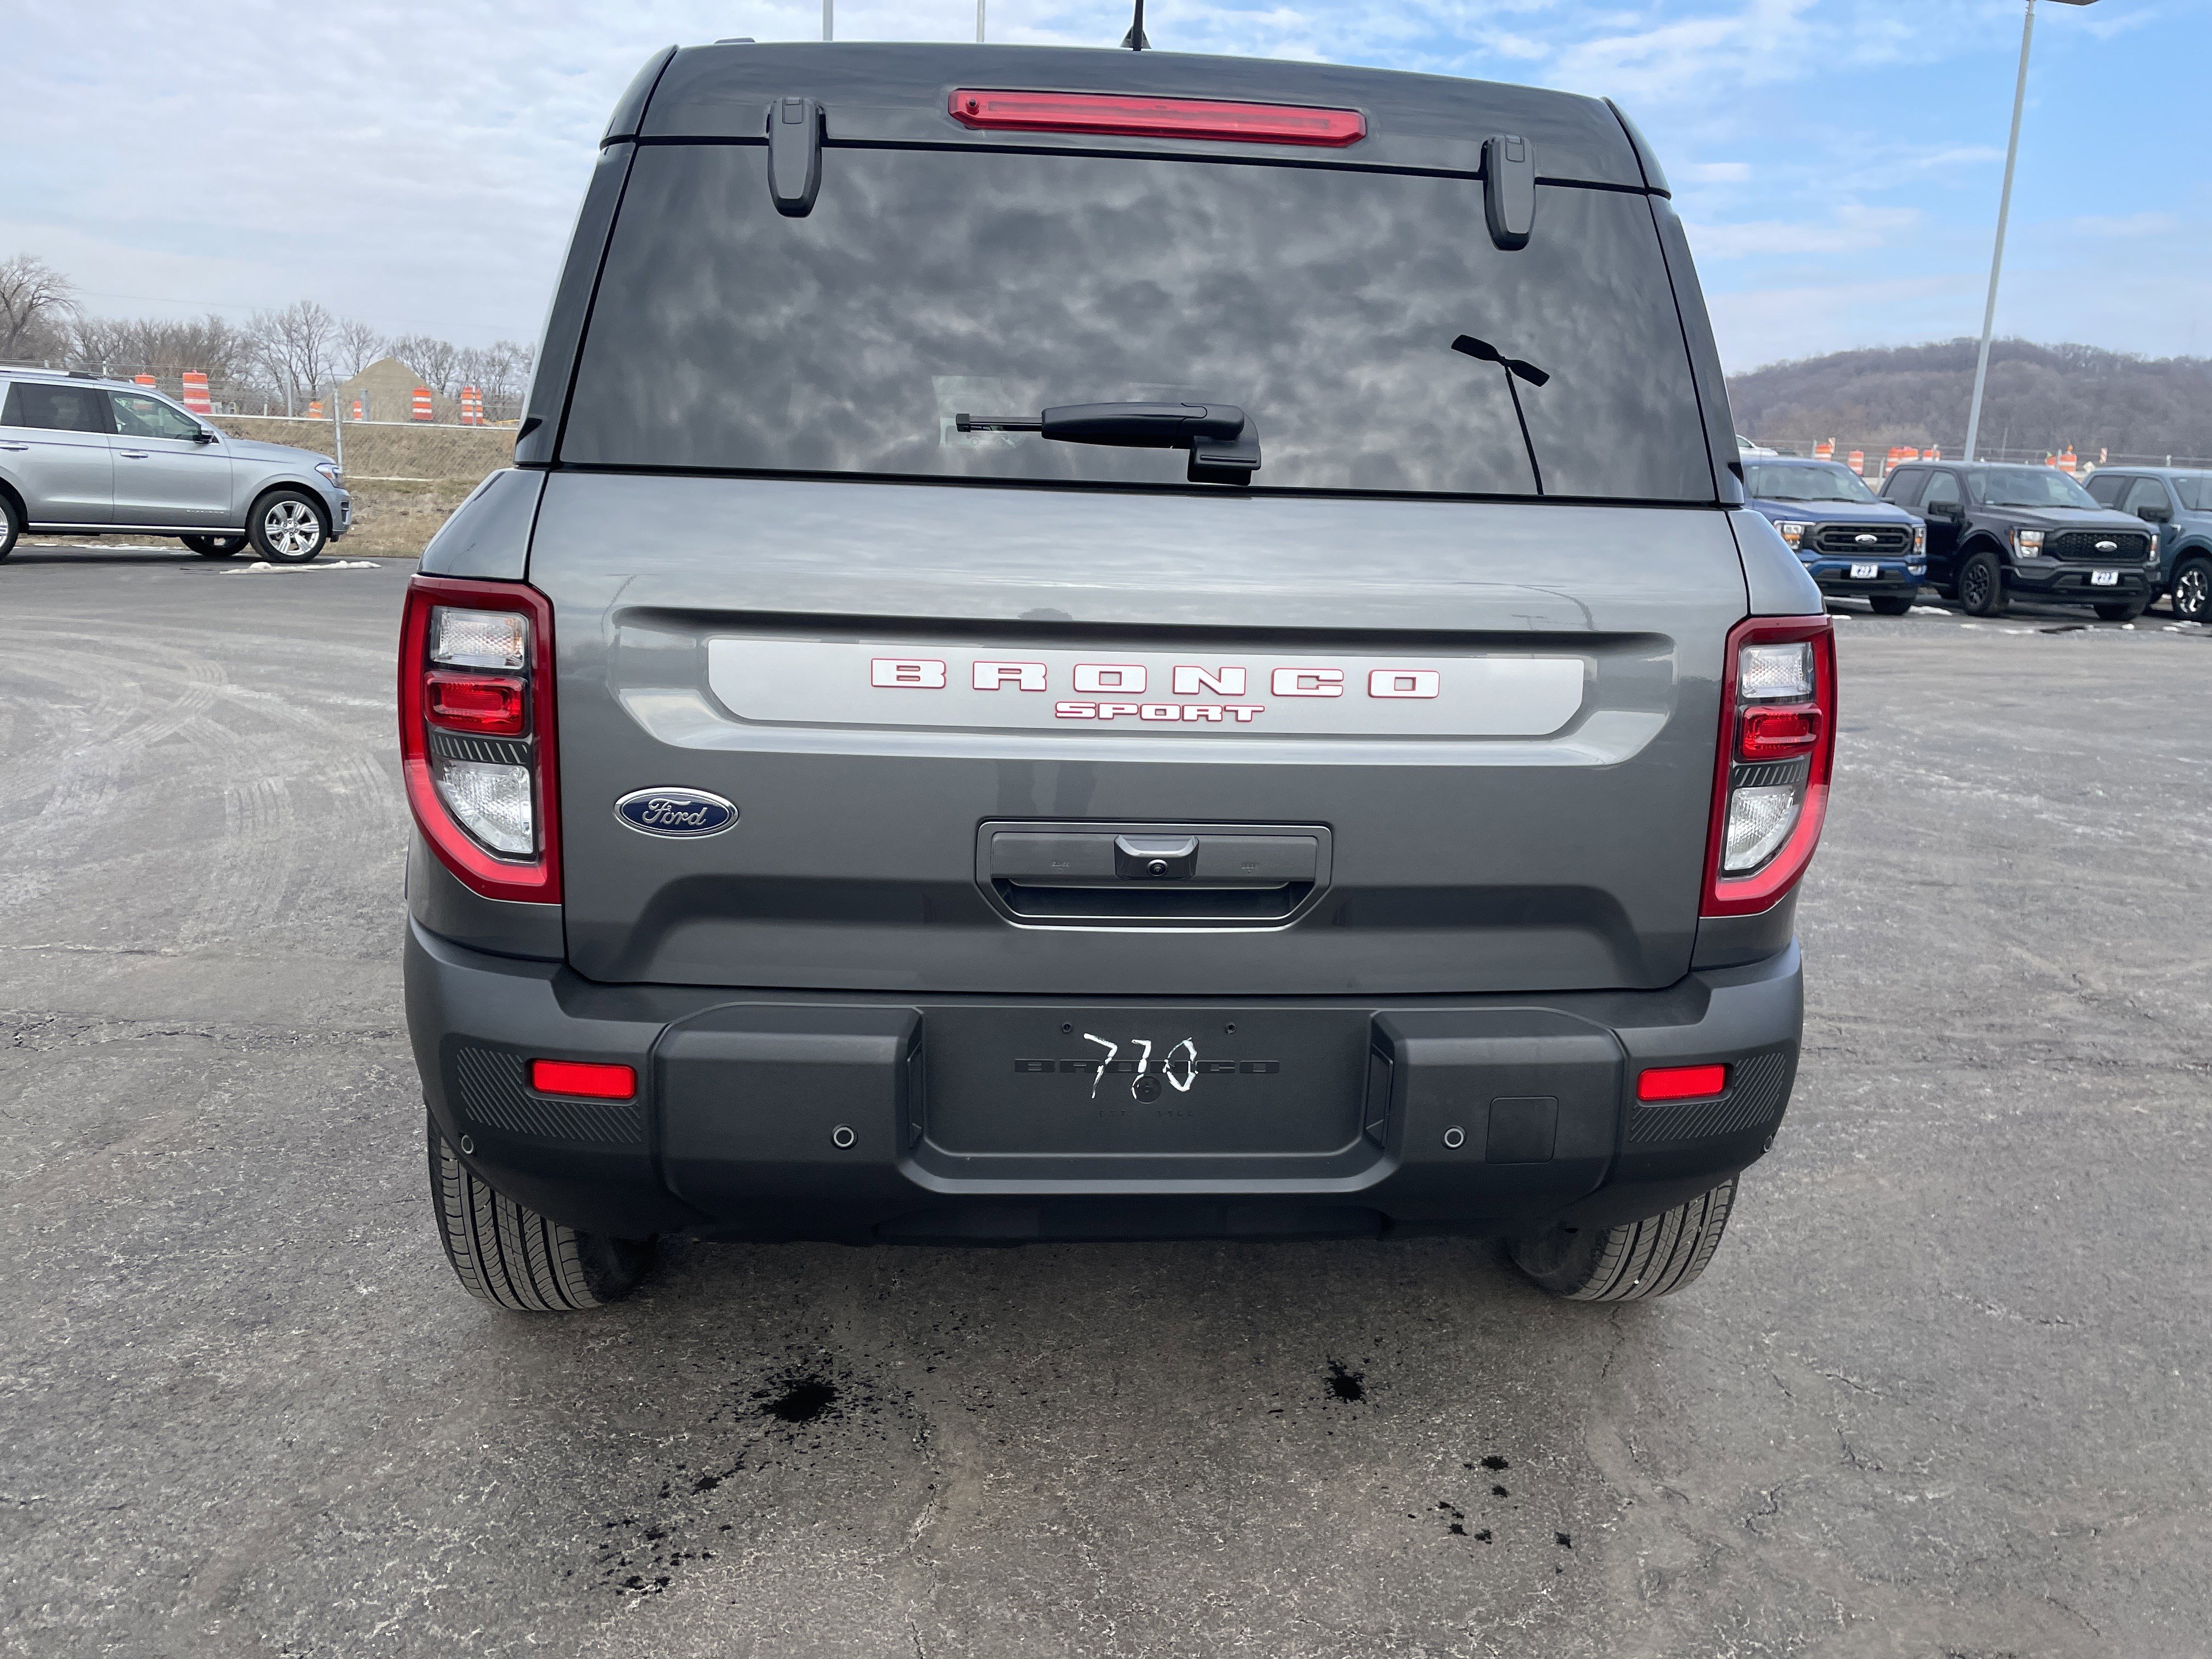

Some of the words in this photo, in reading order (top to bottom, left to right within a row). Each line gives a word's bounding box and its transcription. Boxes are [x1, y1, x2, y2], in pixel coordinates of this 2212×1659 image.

[871, 658, 1440, 698] BRONCO
[1055, 702, 1265, 722] SPORT
[642, 798, 708, 826] Ford
[1083, 1033, 1198, 1099] 770
